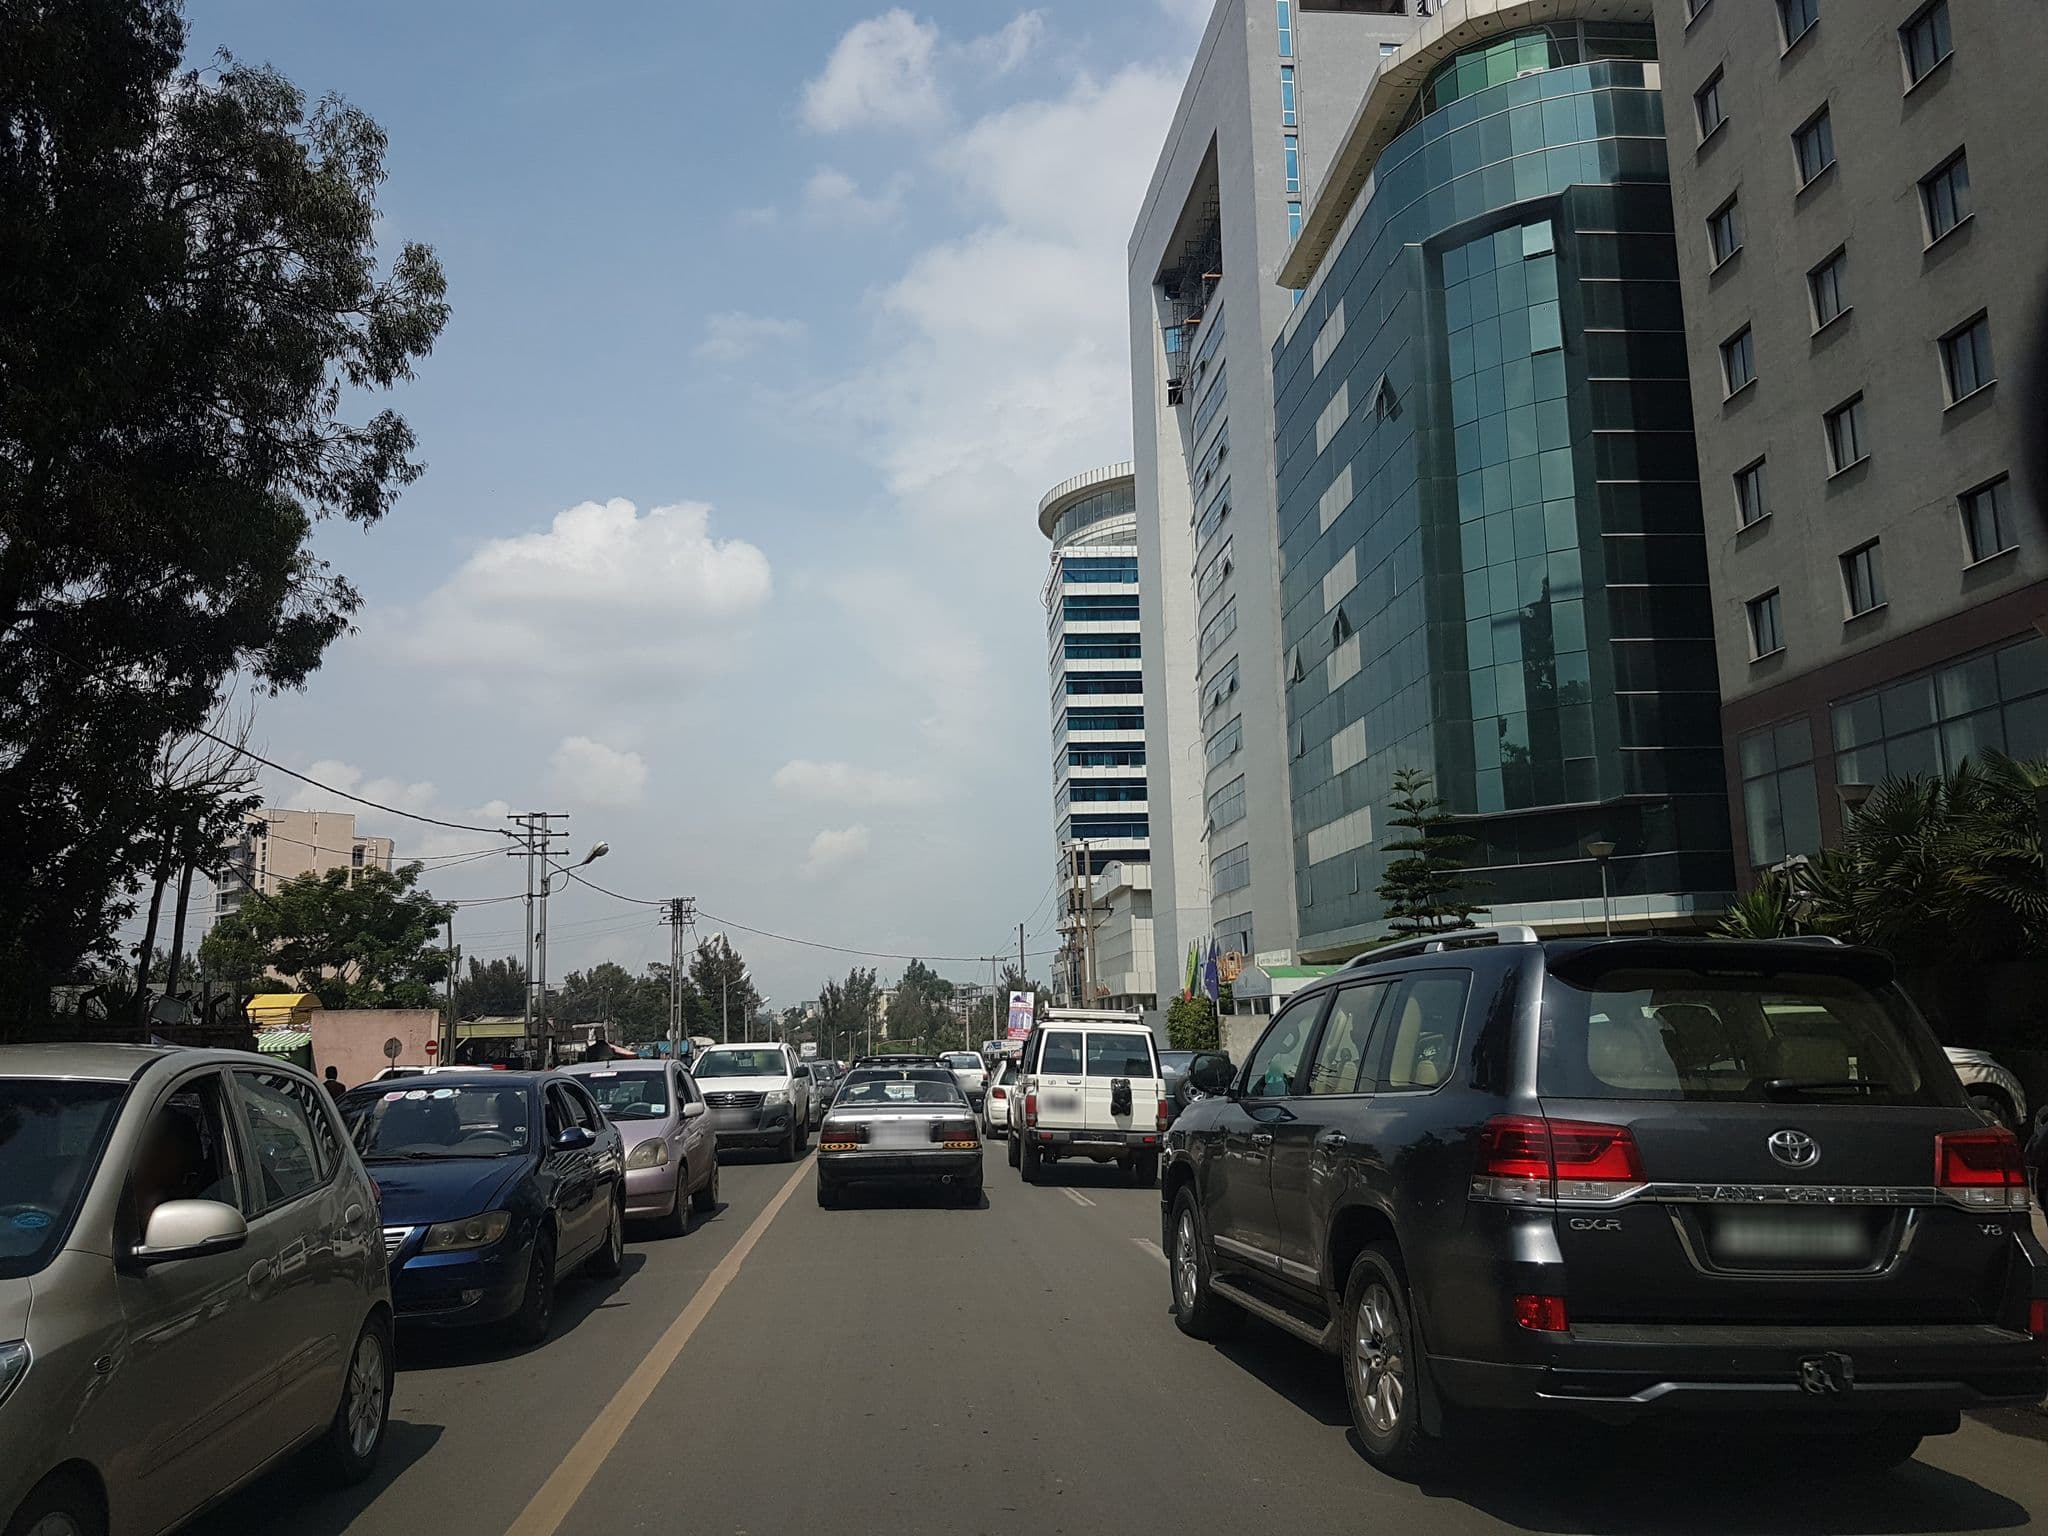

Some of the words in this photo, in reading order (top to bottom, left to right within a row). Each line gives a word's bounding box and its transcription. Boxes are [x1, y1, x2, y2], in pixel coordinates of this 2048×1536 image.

[1695, 1185, 1767, 1201] LAND
[1569, 1218, 1622, 1231] GXR
[1977, 1224, 2003, 1236] V8
